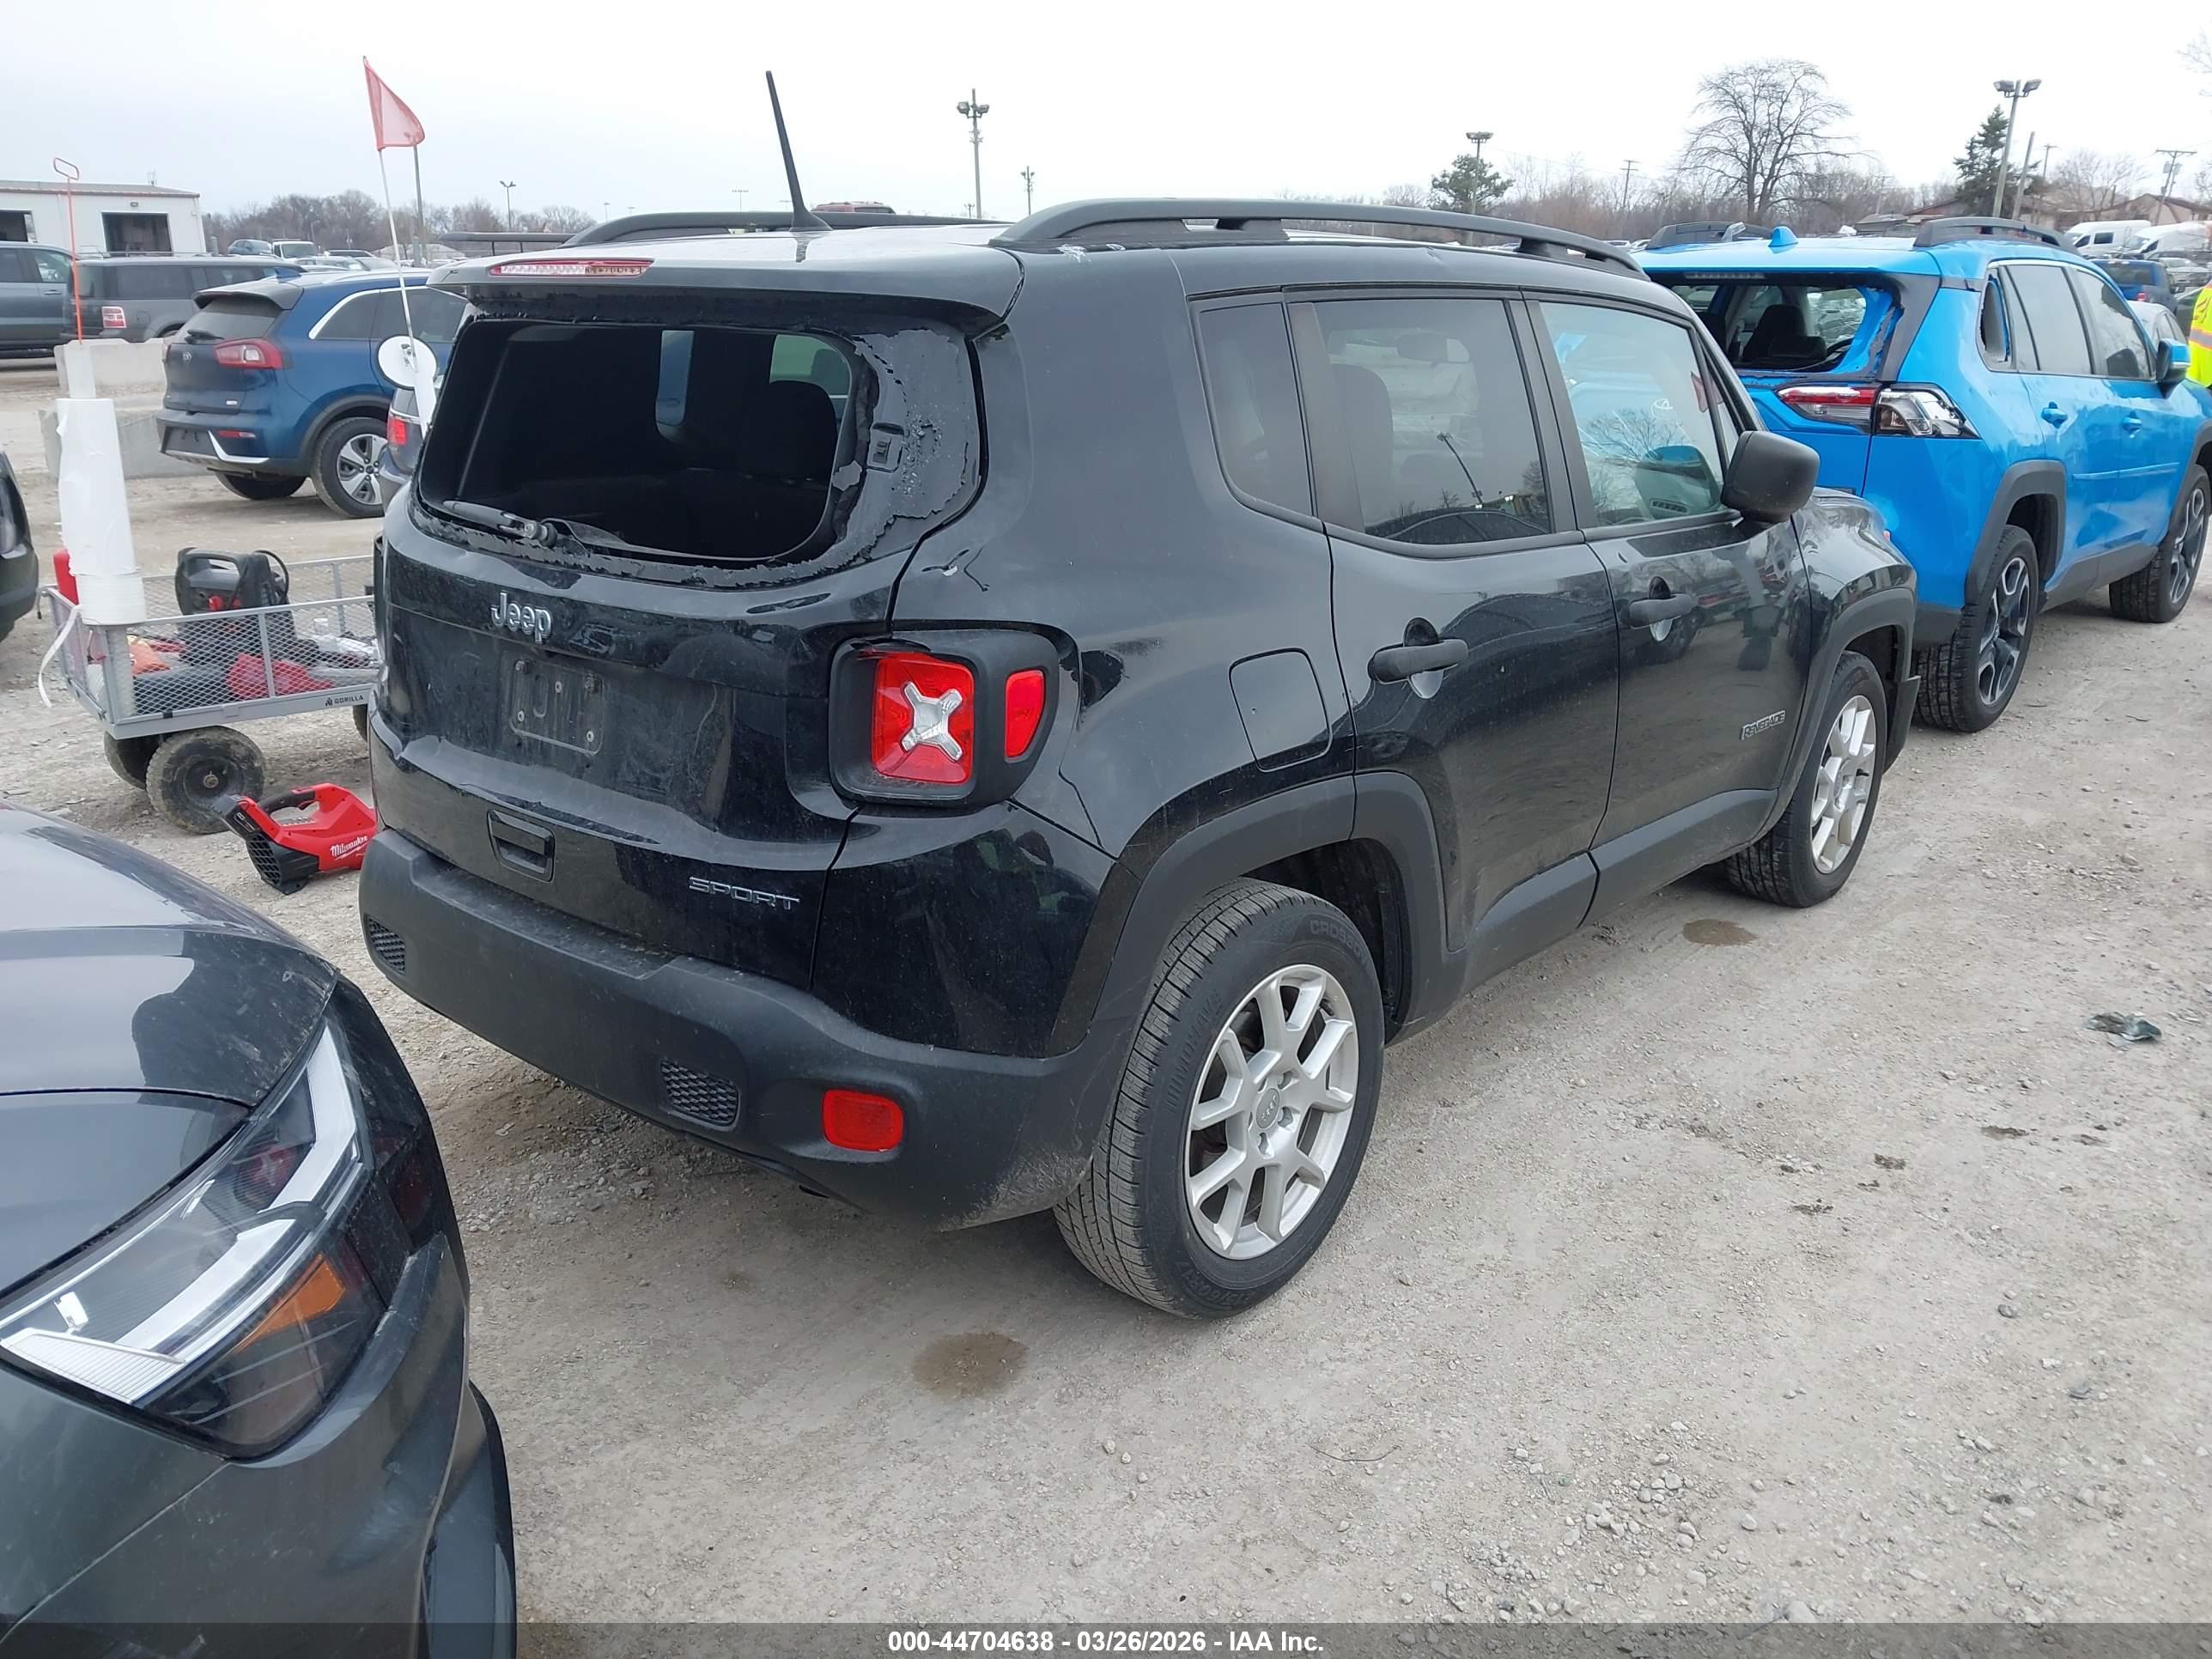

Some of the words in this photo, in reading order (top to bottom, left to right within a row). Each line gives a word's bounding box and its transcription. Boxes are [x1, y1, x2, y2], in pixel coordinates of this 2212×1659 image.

[490, 590, 552, 645] Jeep
[334, 695, 365, 704] GORILLA
[1740, 709, 1786, 741] RENEGADE
[330, 835, 369, 858] Milwaukee
[689, 876, 800, 910] SPORT
